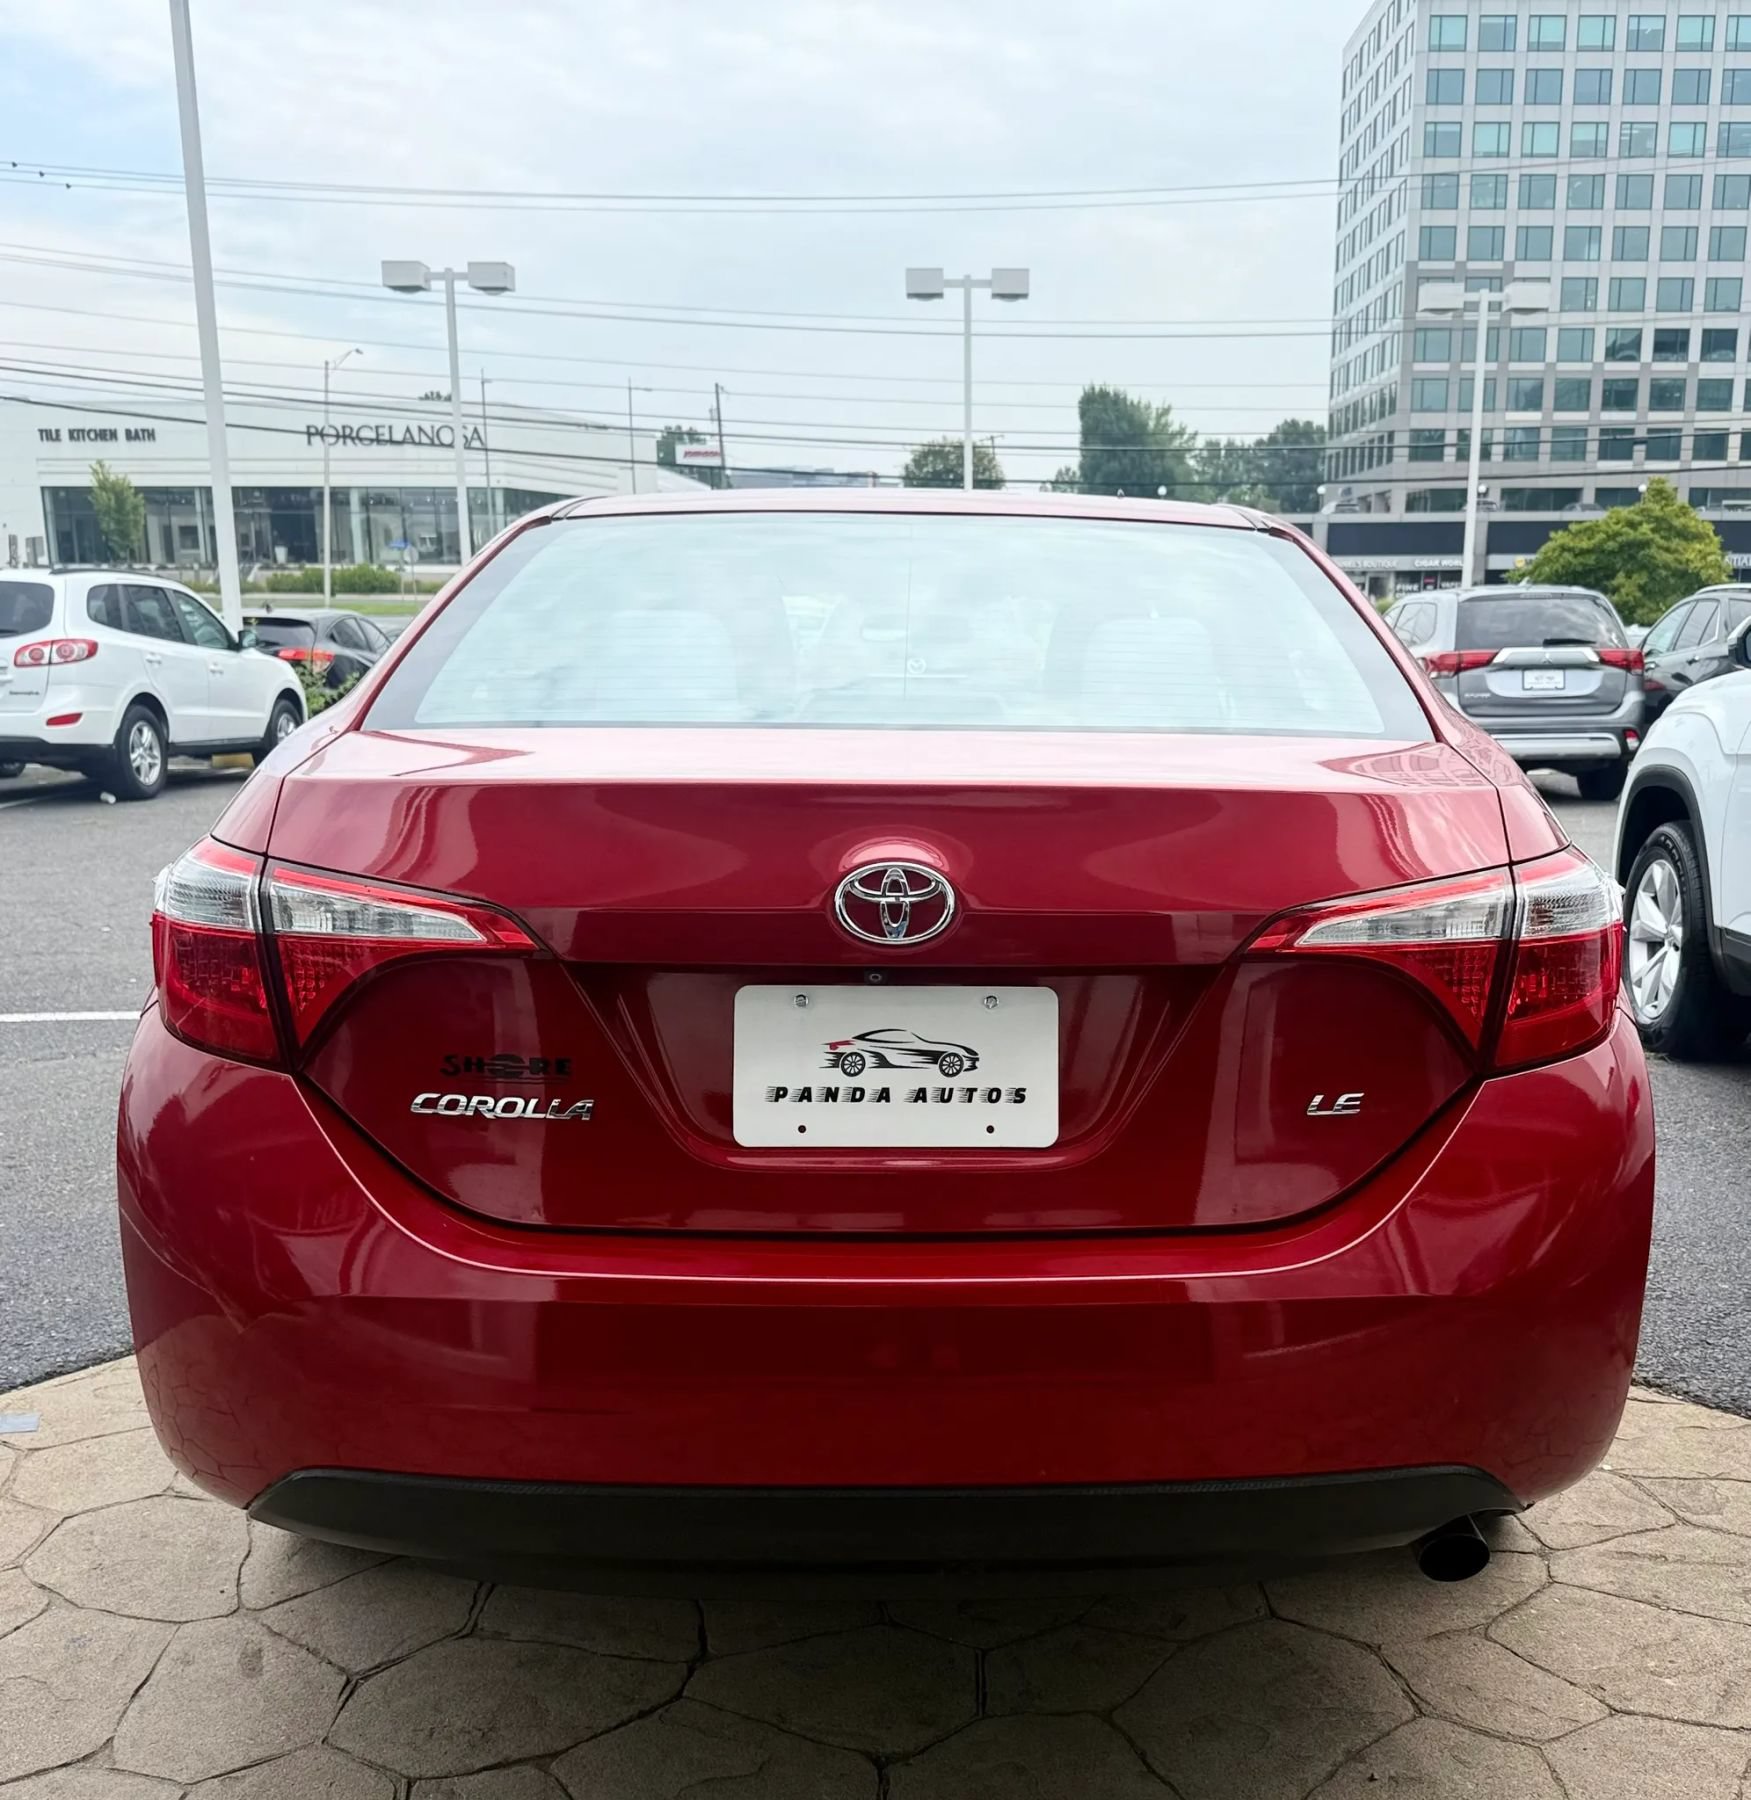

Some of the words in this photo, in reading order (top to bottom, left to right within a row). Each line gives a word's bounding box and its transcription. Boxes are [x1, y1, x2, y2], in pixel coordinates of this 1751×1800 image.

[37, 428, 62, 442] TILE
[67, 428, 118, 442] KITCHEN
[124, 428, 157, 442] BATH
[1414, 559, 1440, 568] CIGAR
[1440, 559, 1464, 568] WORL
[440, 1054, 573, 1078] SHORE
[765, 1086, 891, 1103] PANDA
[903, 1087, 1027, 1103] AUTOS
[1307, 1093, 1365, 1115] LE
[410, 1093, 595, 1120] COROLLA
